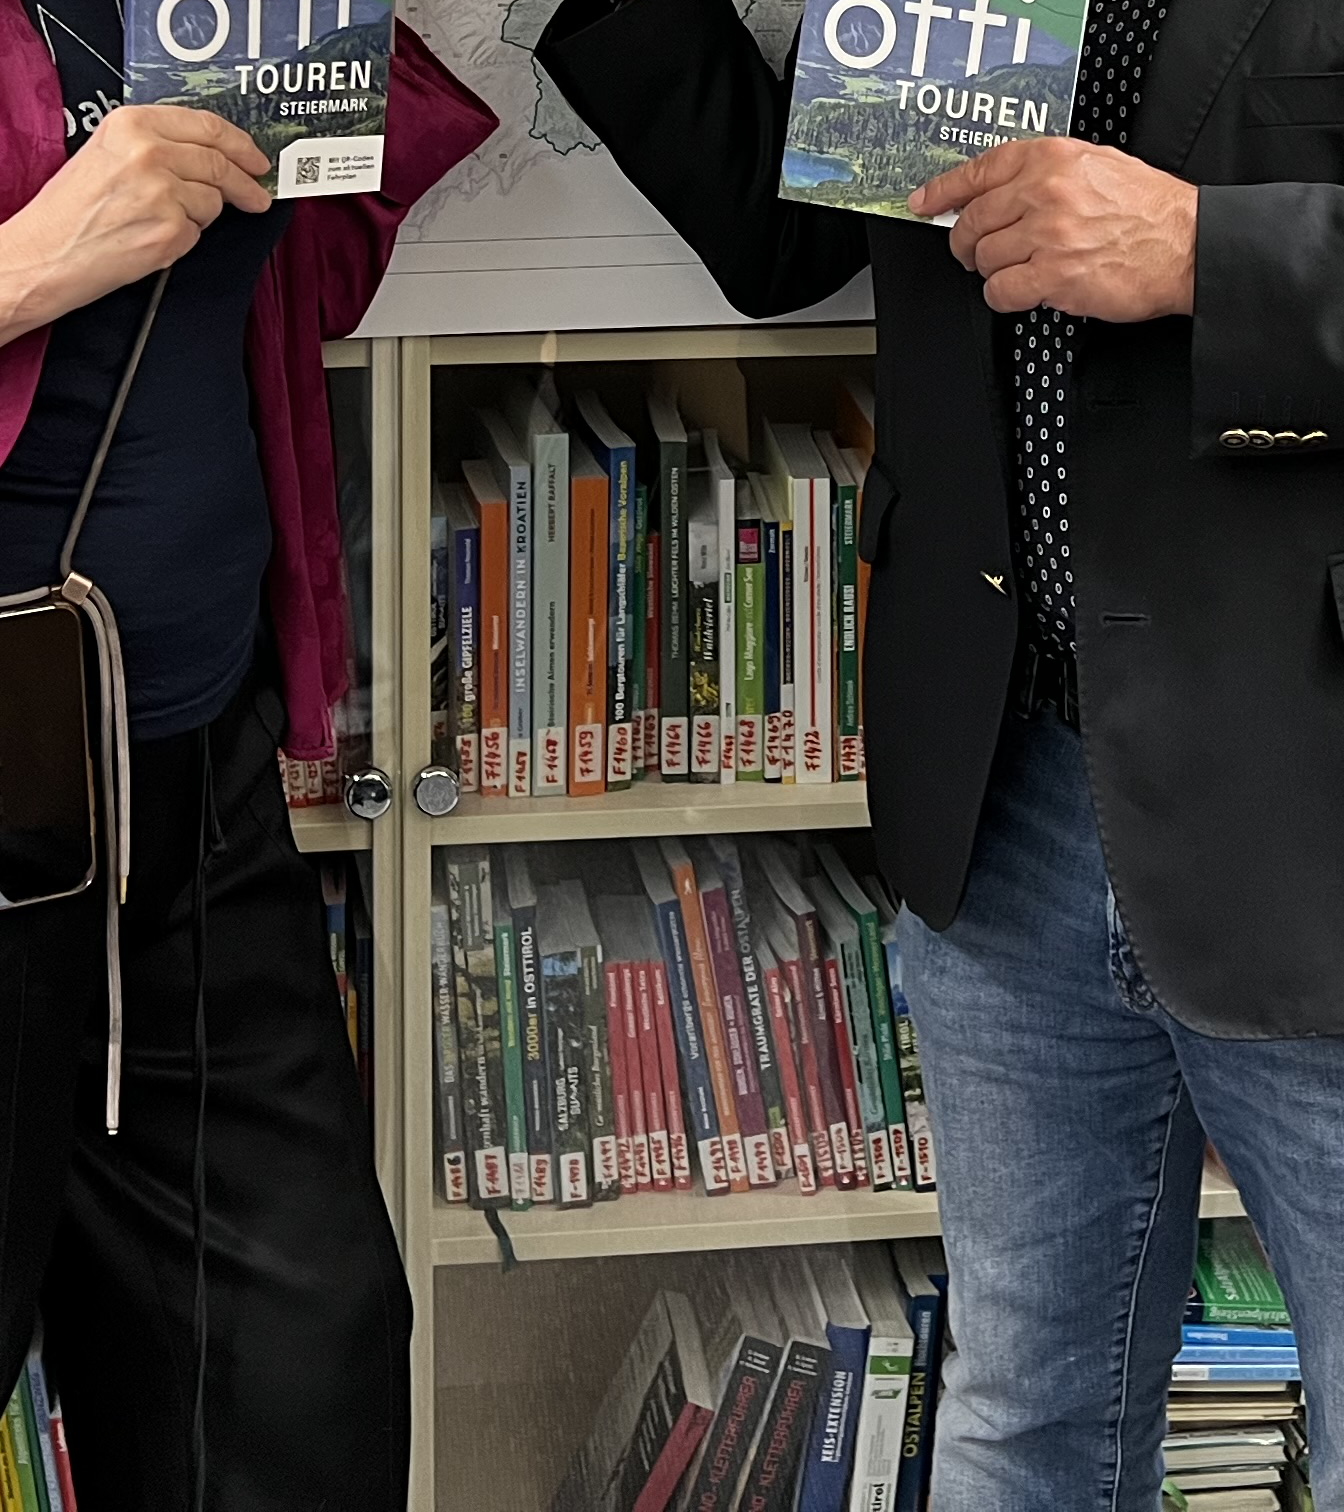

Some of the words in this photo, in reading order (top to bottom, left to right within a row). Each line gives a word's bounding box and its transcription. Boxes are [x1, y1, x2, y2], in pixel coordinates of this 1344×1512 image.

[234, 60, 372, 95] TOUREN
[279, 97, 368, 116] STEIERMARK
[896, 79, 1049, 133] TOUREN
[939, 126, 1019, 148] STEIERM
[515, 481, 527, 554] KROATIEN
[515, 557, 527, 575] IN
[514, 578, 527, 693] INSELWANDERN
[614, 647, 626, 698] Bergtouren
[614, 701, 624, 722] 100
[523, 925, 534, 993] OSTTIROL
[742, 957, 759, 982] DER
[527, 994, 537, 1009] in
[526, 1013, 540, 1061] 3000er
[746, 984, 773, 1070] TRAUMGRATE
[902, 1371, 926, 1458] OSTALPEN
